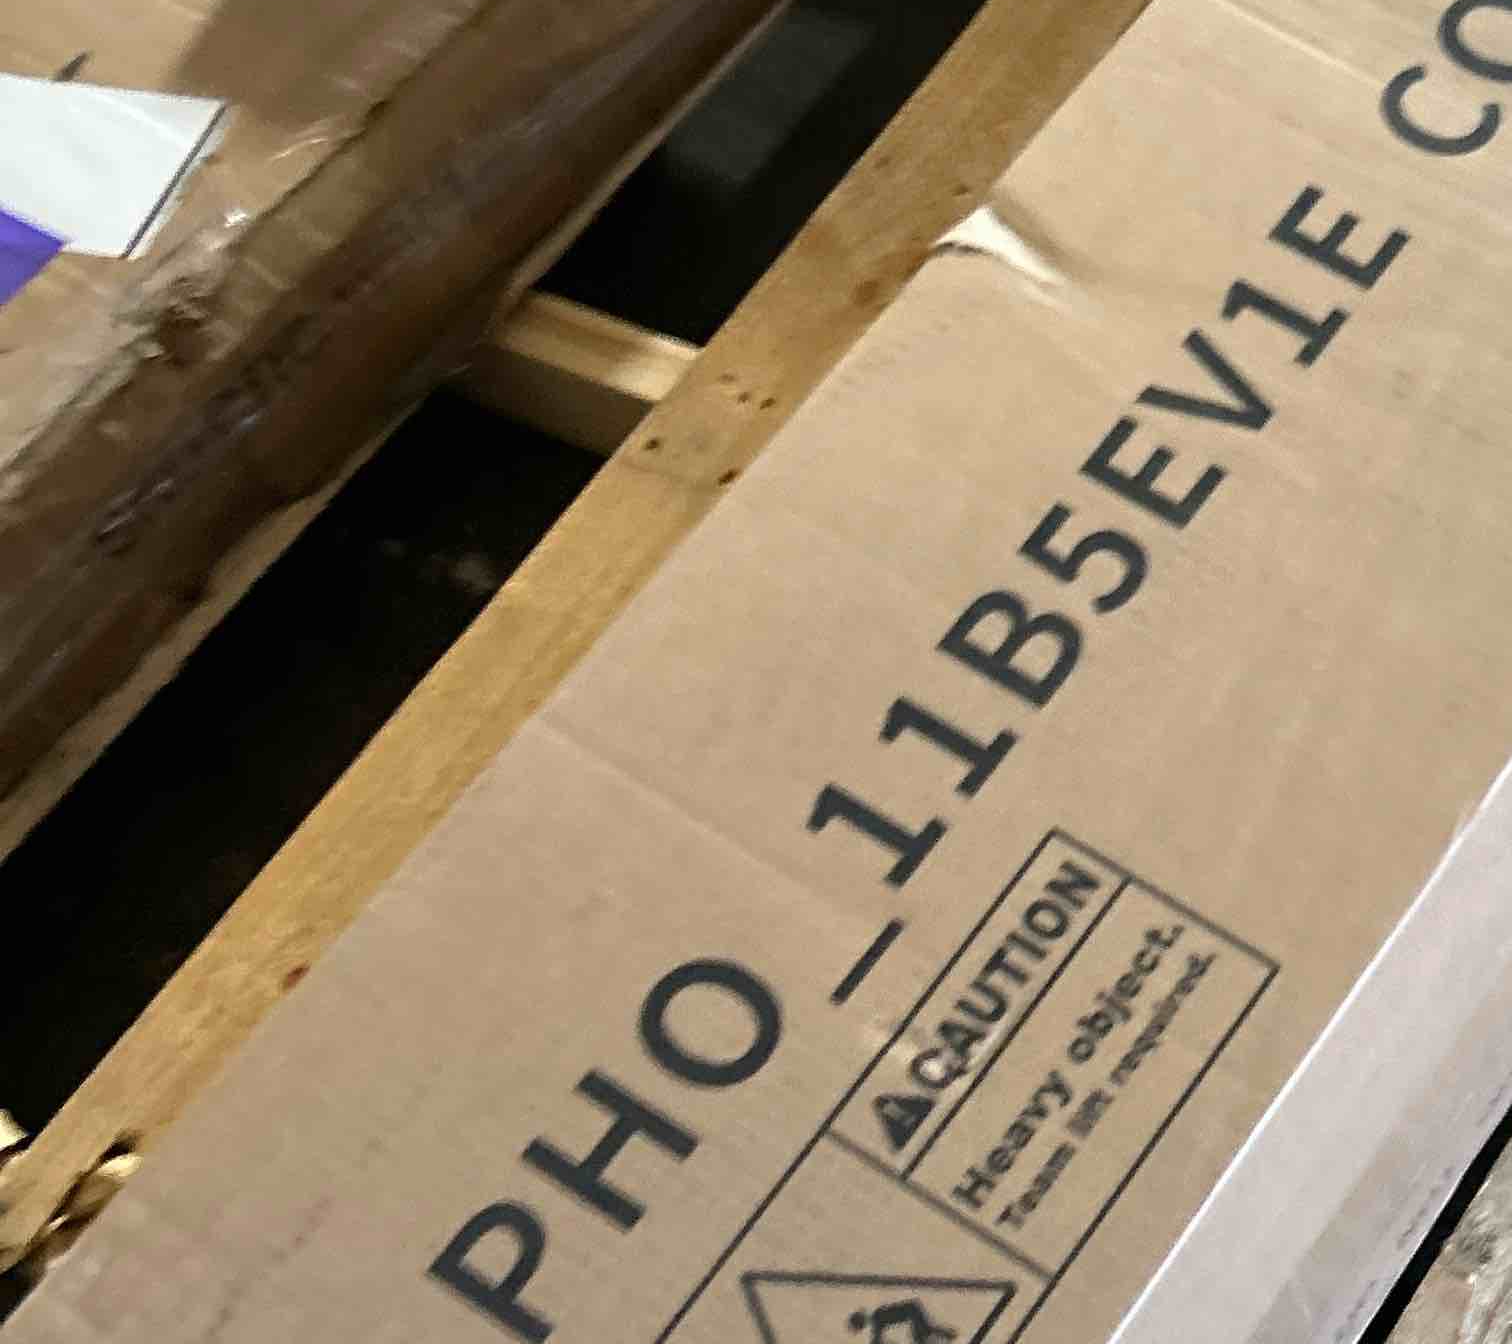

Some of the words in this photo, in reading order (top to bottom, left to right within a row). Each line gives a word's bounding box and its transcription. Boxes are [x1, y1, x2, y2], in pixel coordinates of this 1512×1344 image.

[908, 860, 1100, 1088] CAUTION
[951, 1069, 1074, 1209] Heavy
[1067, 924, 1185, 1065] object.
[994, 1141, 1077, 1229] Team
[1108, 952, 1217, 1087] required.
